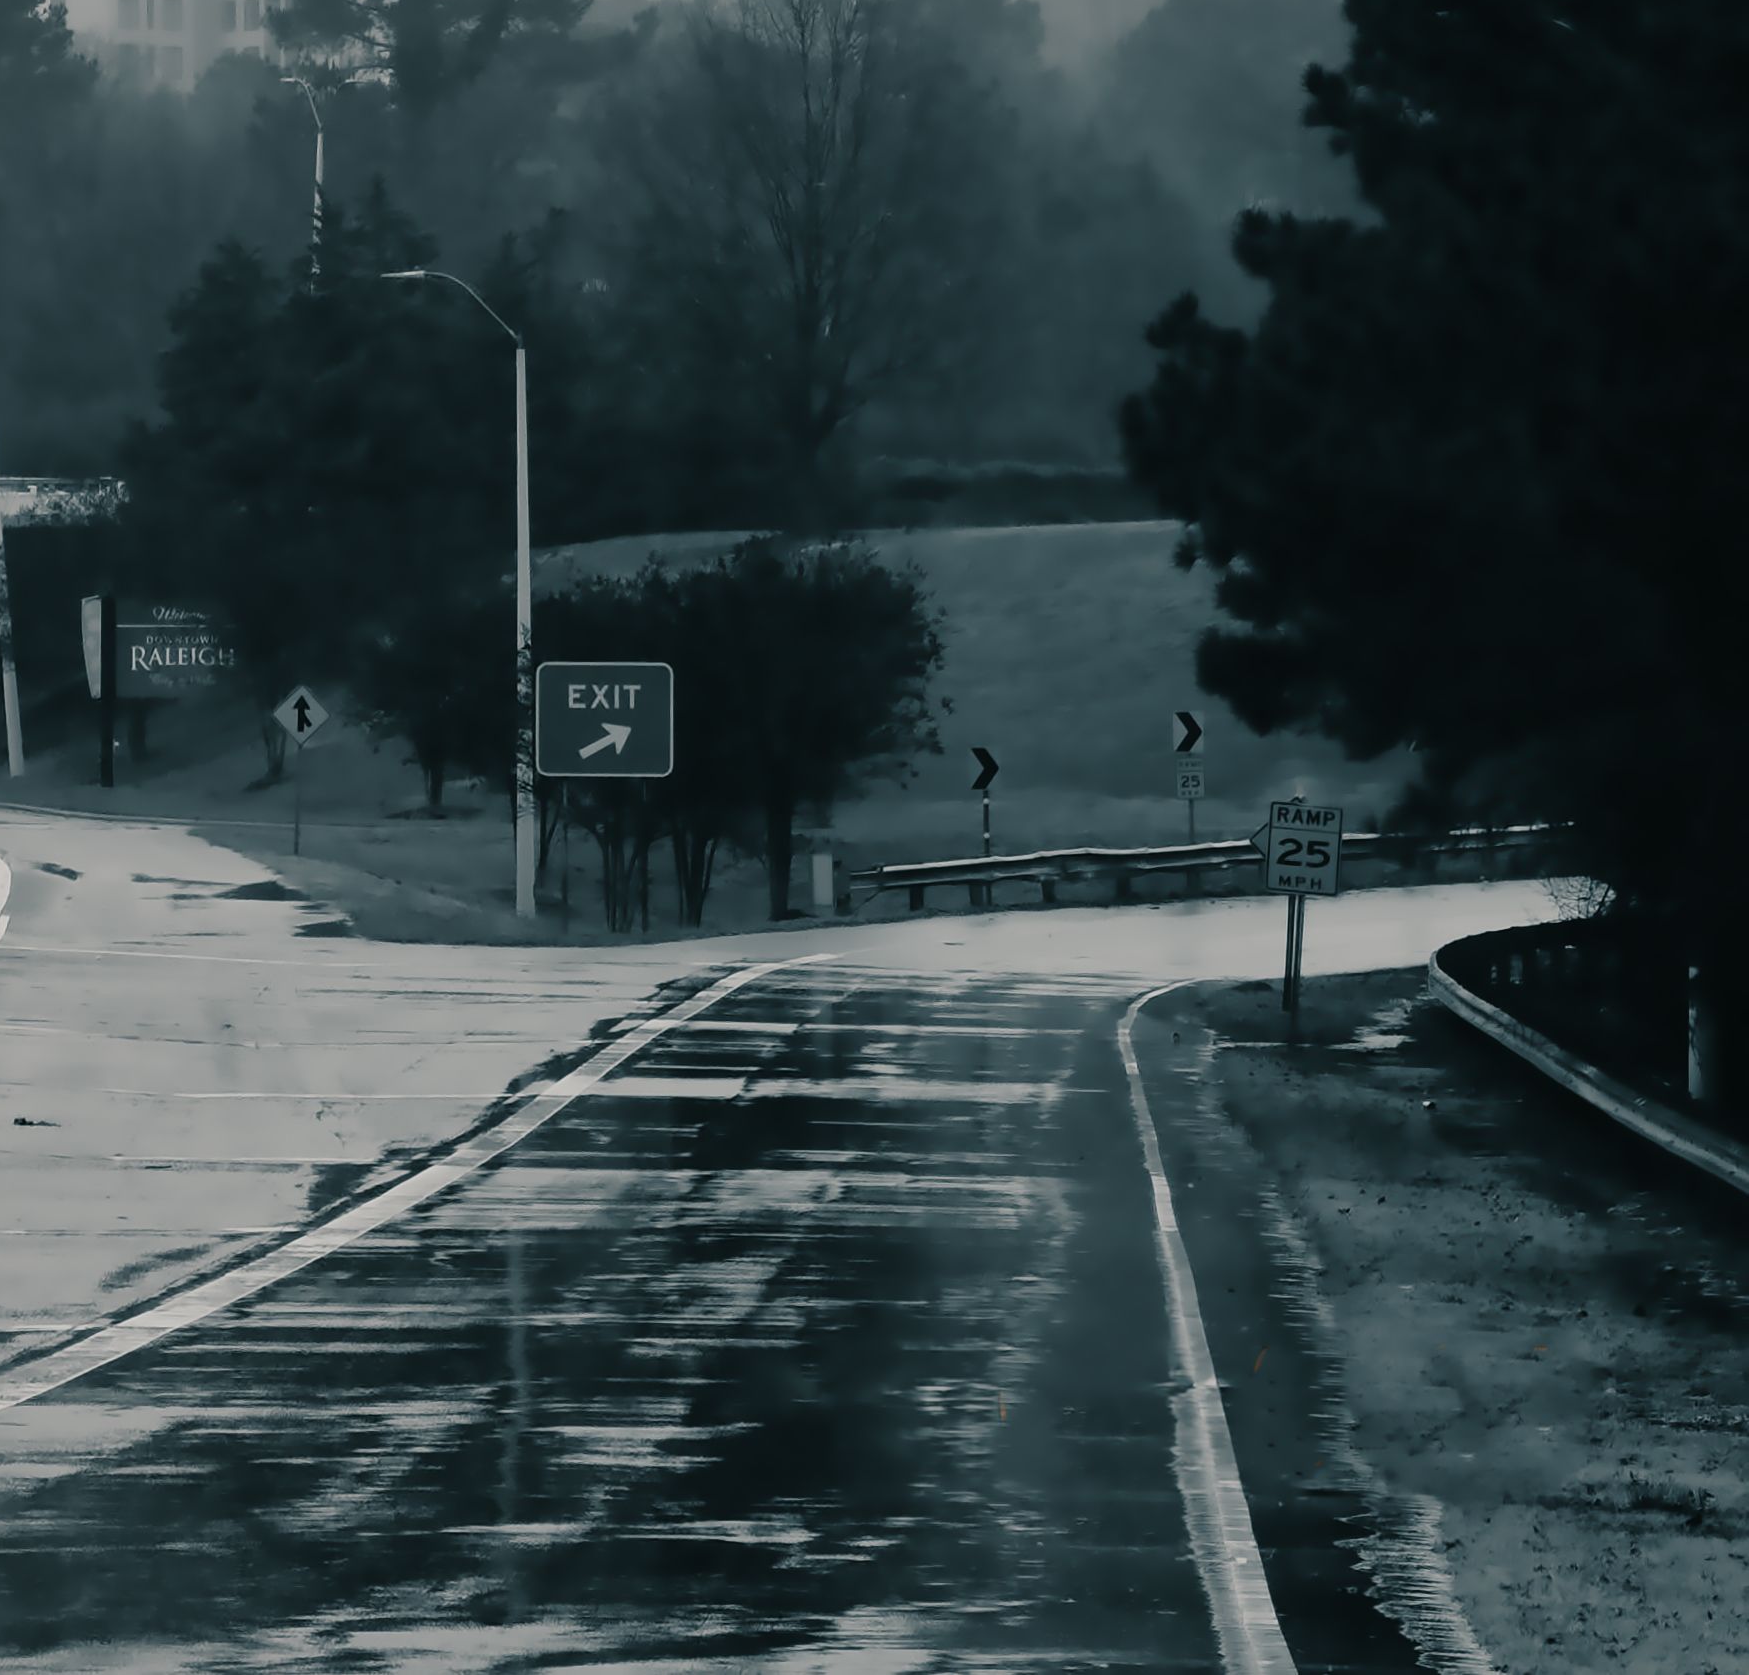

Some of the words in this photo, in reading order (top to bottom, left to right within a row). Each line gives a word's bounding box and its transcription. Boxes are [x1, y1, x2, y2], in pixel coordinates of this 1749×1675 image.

[131, 645, 235, 671] RALEIGH
[568, 684, 641, 709] EXIT
[1181, 775, 1201, 788] 25
[1277, 807, 1335, 826] RAMP
[1276, 838, 1330, 868] 25
[1278, 875, 1322, 890] MPH
